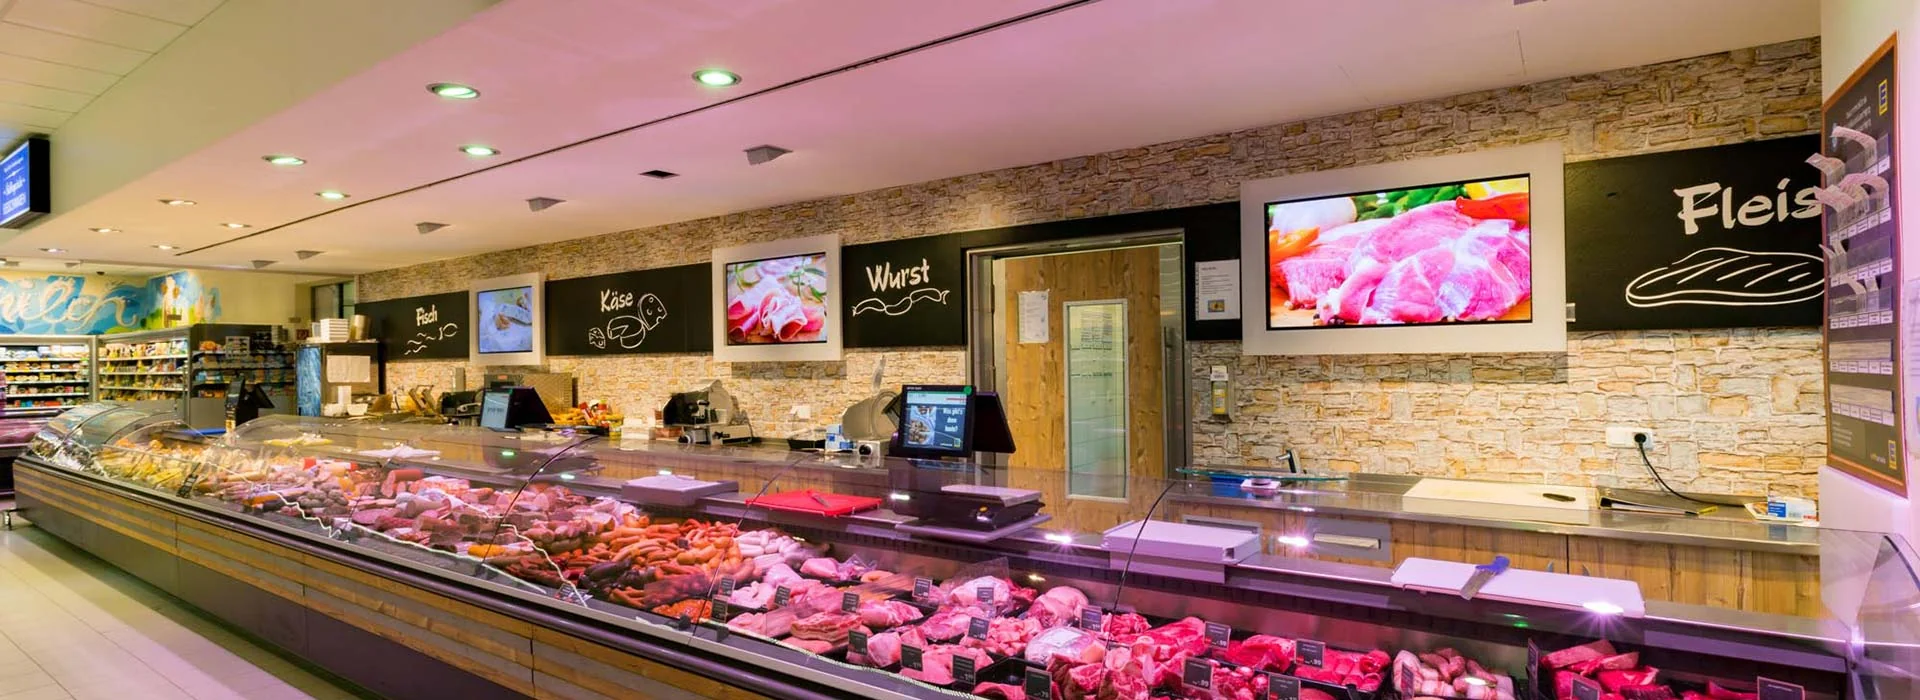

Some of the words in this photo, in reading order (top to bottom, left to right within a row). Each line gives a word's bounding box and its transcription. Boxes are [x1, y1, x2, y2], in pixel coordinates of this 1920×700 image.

[865, 257, 931, 293] Wurst
[600, 288, 634, 313] Käse
[415, 303, 438, 327] Fisch
